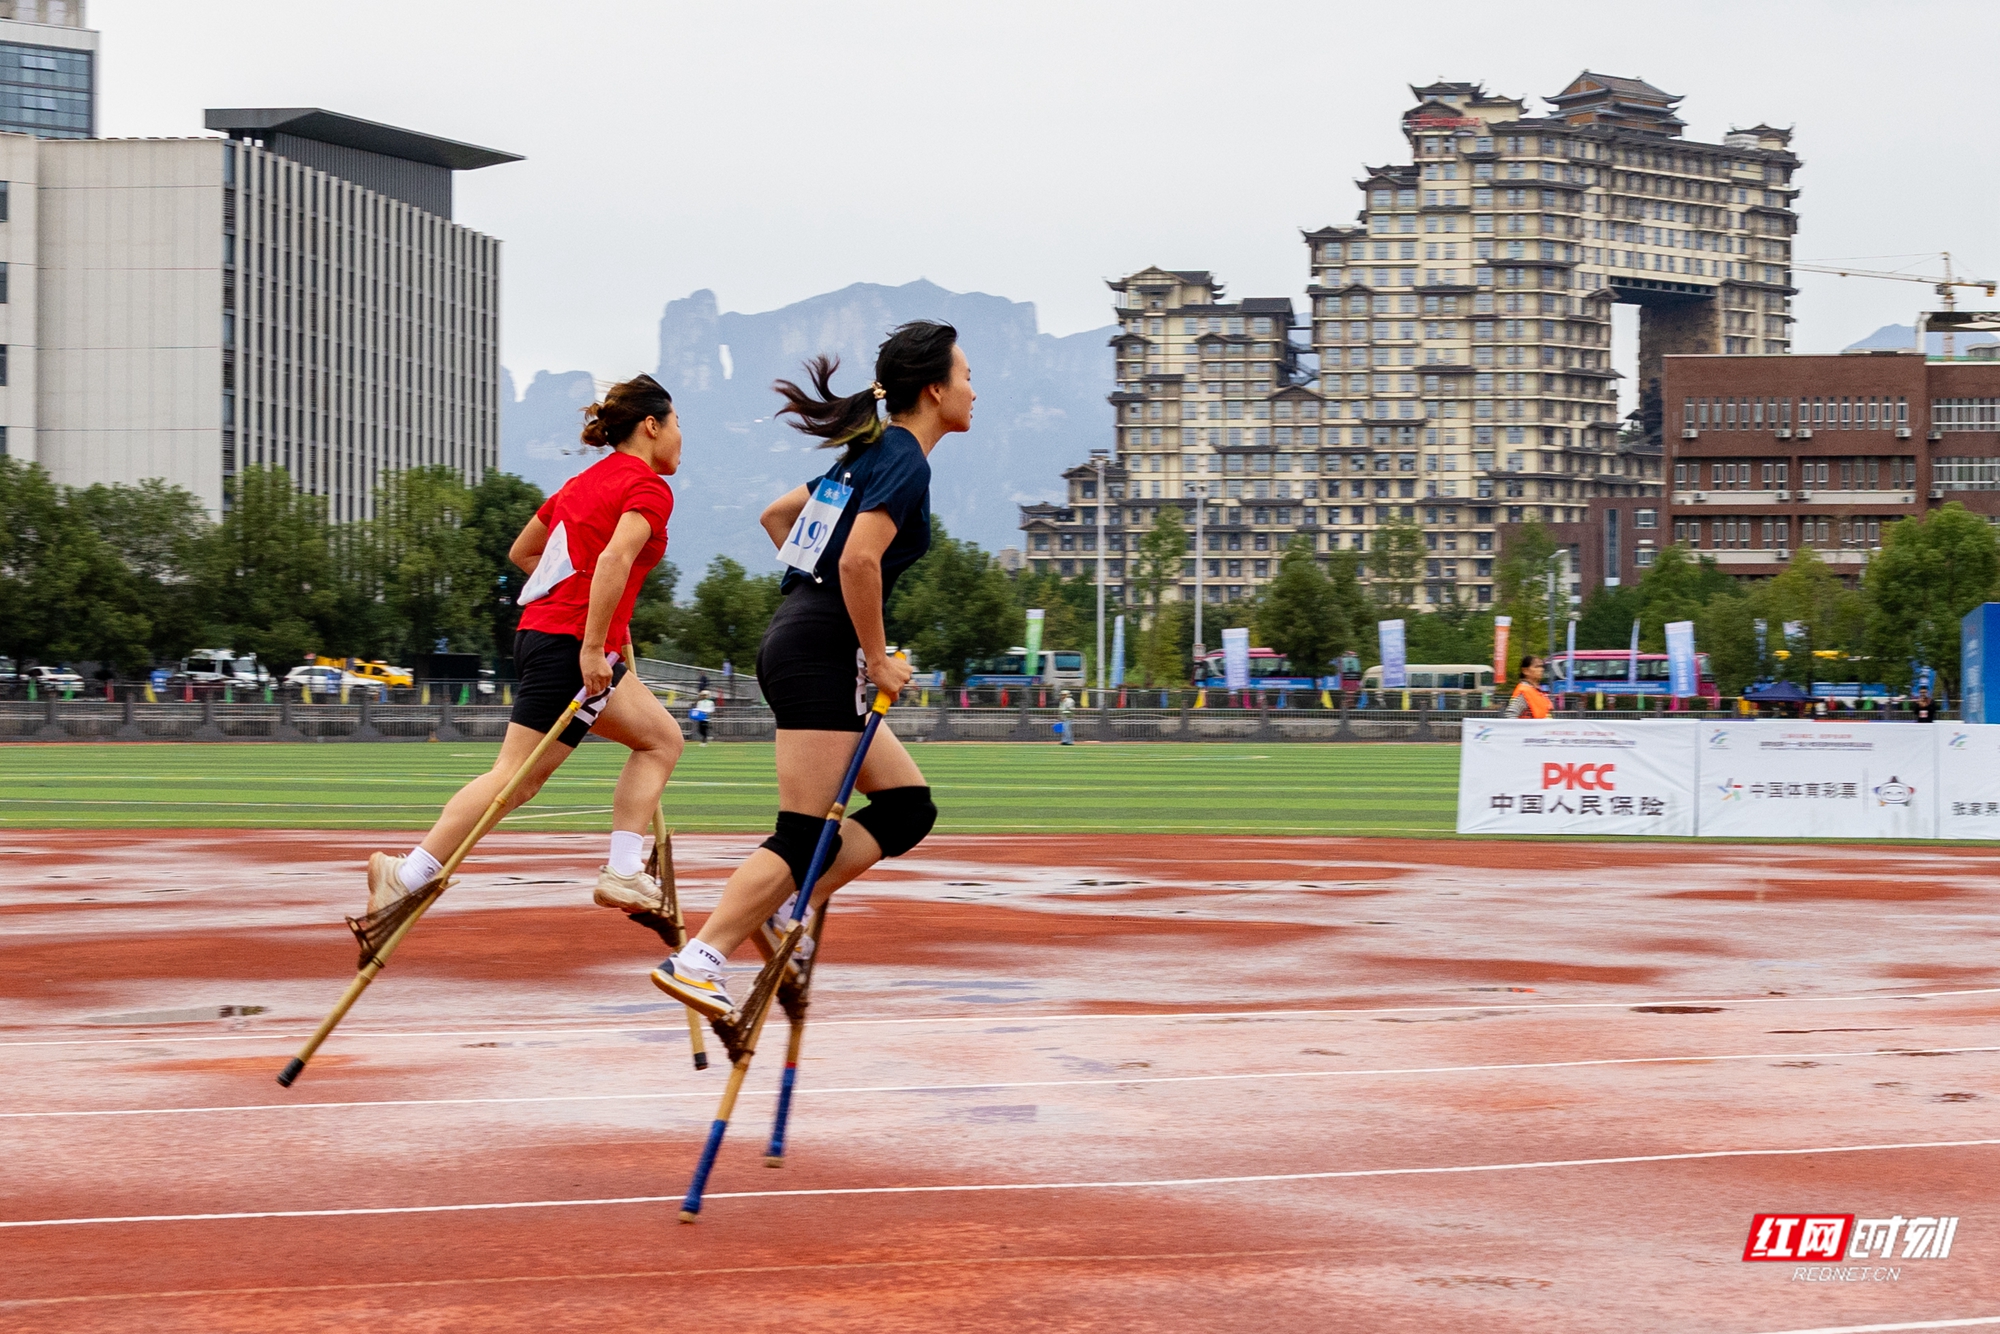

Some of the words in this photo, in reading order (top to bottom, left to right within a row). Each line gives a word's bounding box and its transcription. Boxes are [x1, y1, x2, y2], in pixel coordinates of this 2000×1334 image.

[1541, 762, 1616, 791] PICC
[1751, 781, 1859, 799] 中国体育彩票
[1490, 793, 1666, 817] 中国人民保险
